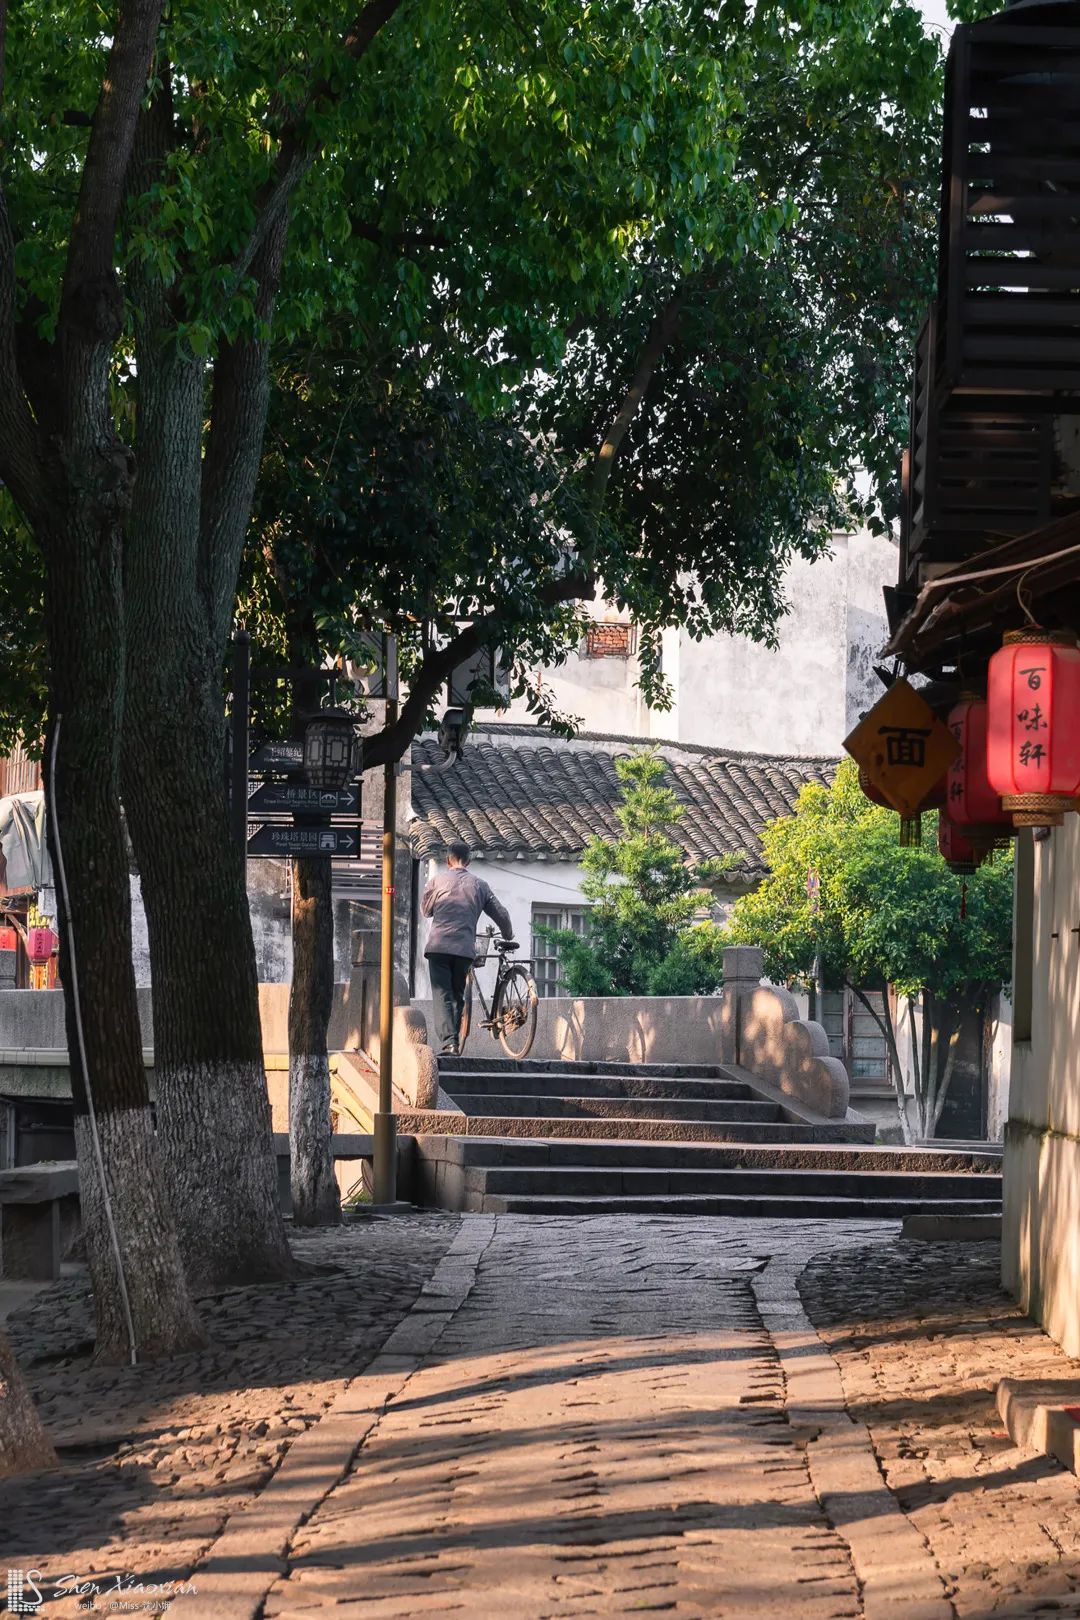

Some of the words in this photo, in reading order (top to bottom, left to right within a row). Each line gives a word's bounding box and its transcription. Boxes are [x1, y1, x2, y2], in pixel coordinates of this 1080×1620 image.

[877, 725, 933, 769] 面
[1016, 667, 1049, 769] 百味轩
